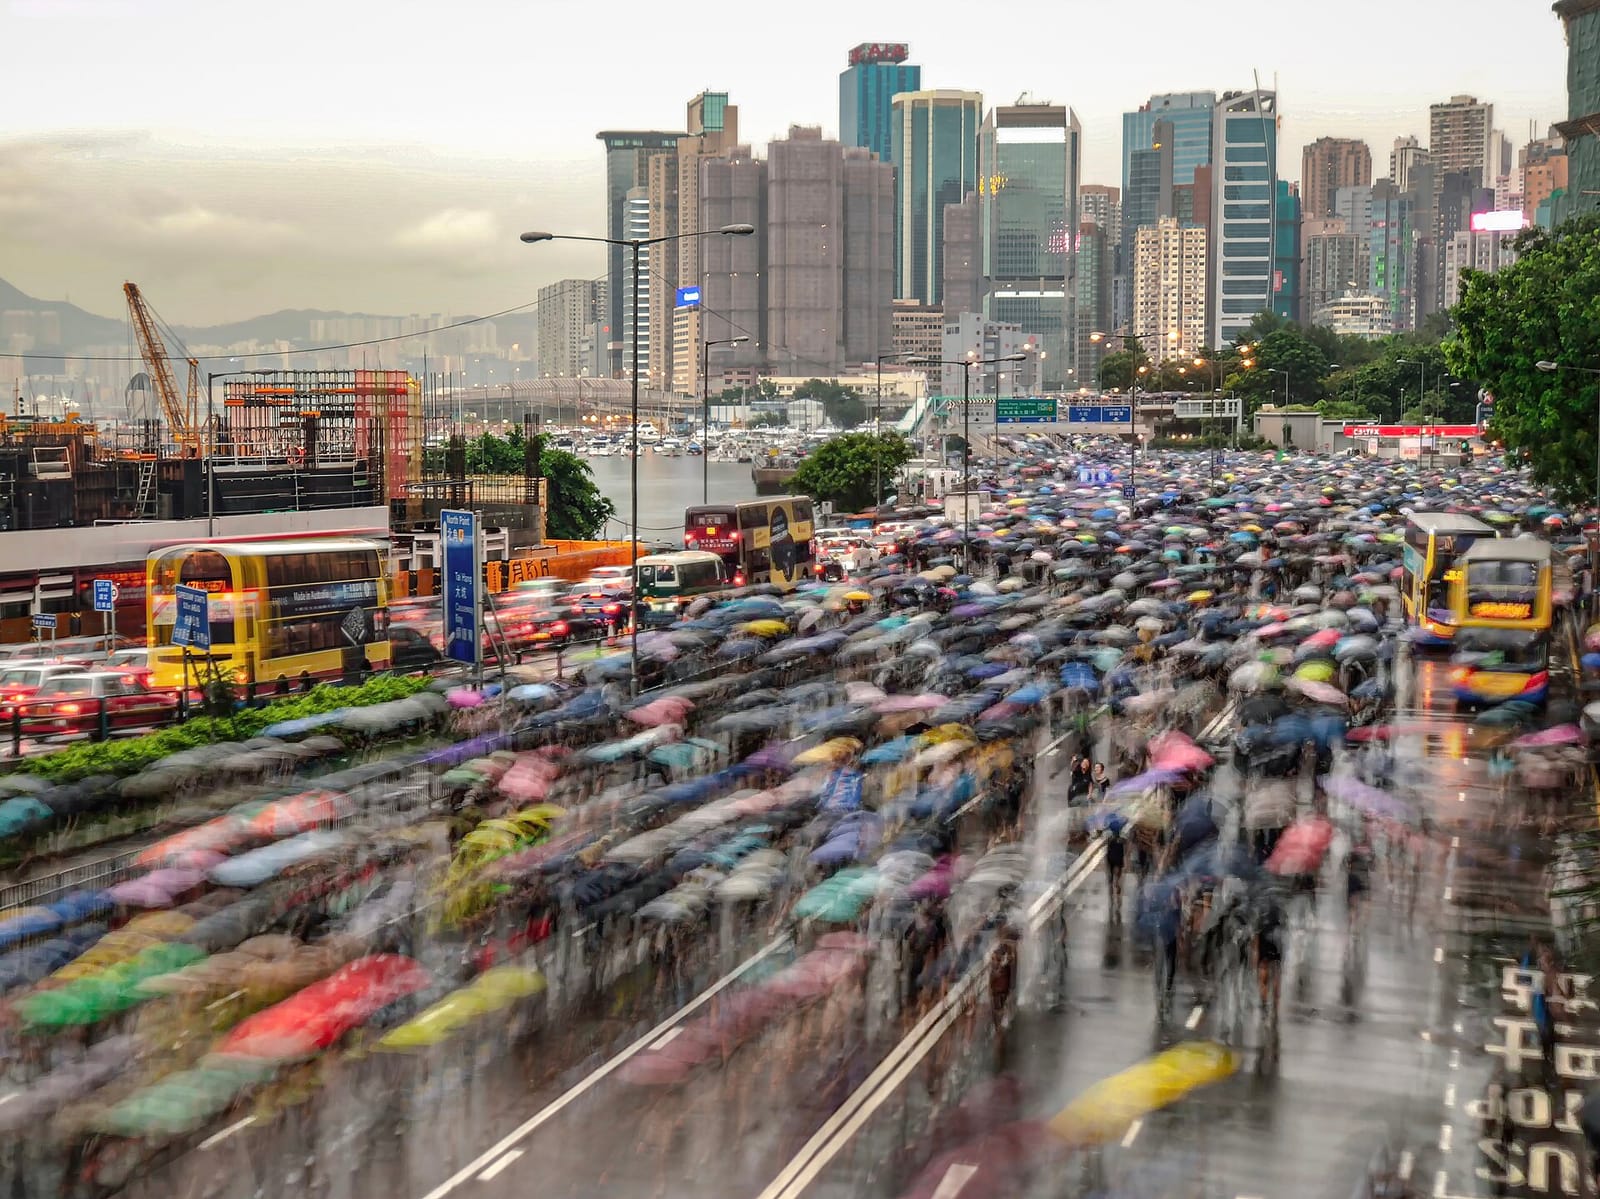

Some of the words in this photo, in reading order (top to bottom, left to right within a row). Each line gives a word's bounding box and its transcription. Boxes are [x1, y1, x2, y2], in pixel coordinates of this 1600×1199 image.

[867, 43, 906, 59] AIA
[446, 515, 458, 524] North
[459, 516, 470, 526] Point
[447, 528, 458, 542] 北角
[461, 573, 472, 585] Hang
[294, 592, 305, 600] Made
[455, 585, 467, 599] 大坑
